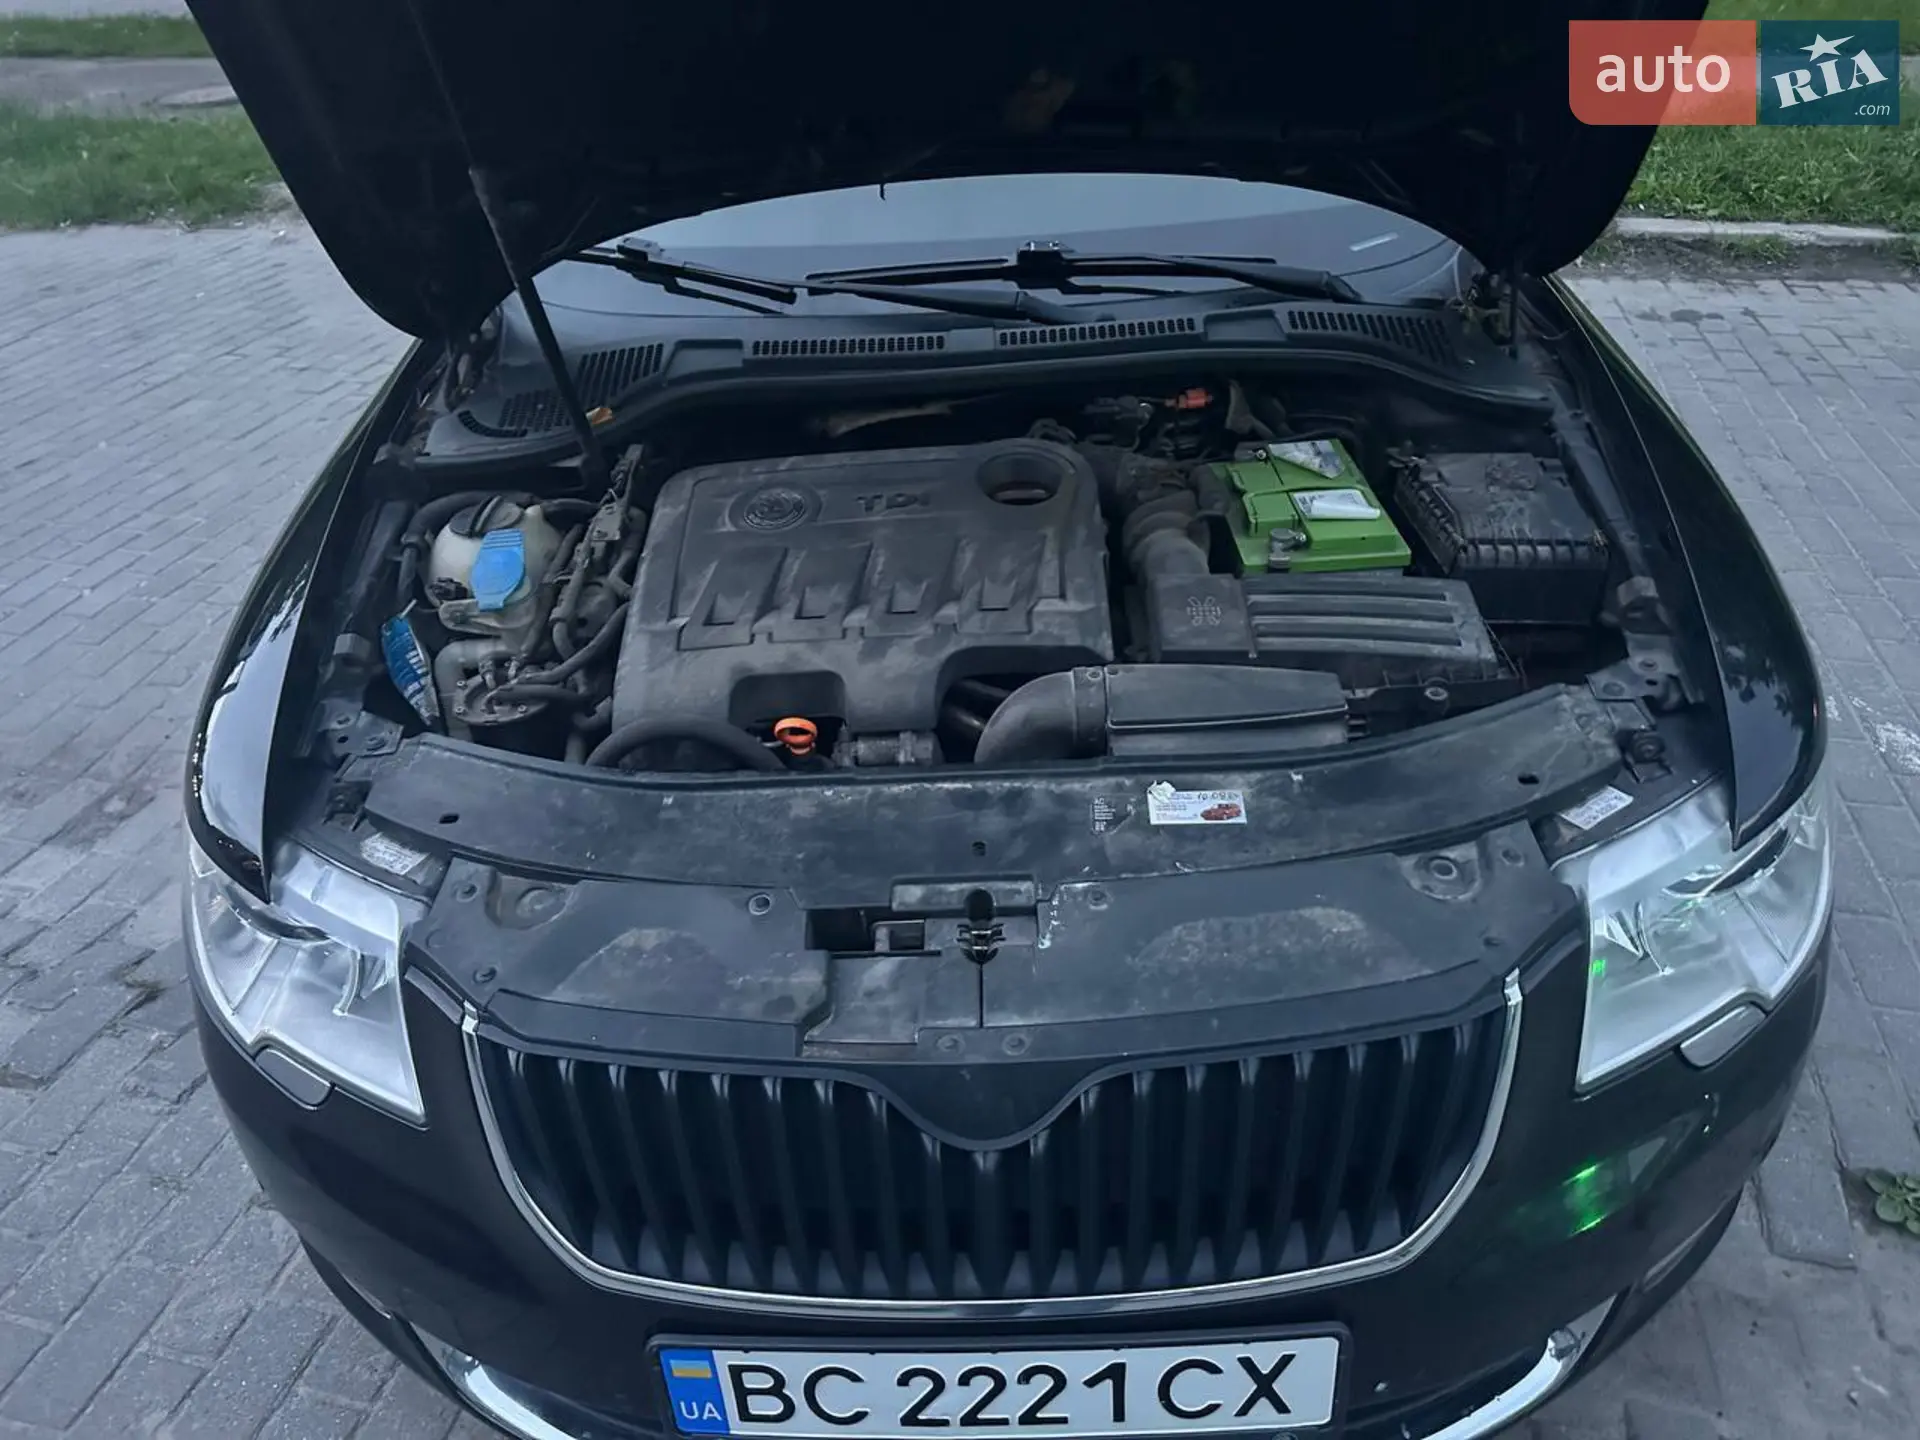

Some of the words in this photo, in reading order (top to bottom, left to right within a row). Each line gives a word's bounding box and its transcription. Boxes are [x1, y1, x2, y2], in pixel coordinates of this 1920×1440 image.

[680, 1401, 726, 1422] UA
[727, 1362, 868, 1425] BC
[896, 1360, 1127, 1426] 2221
[1157, 1353, 1296, 1420] CX
